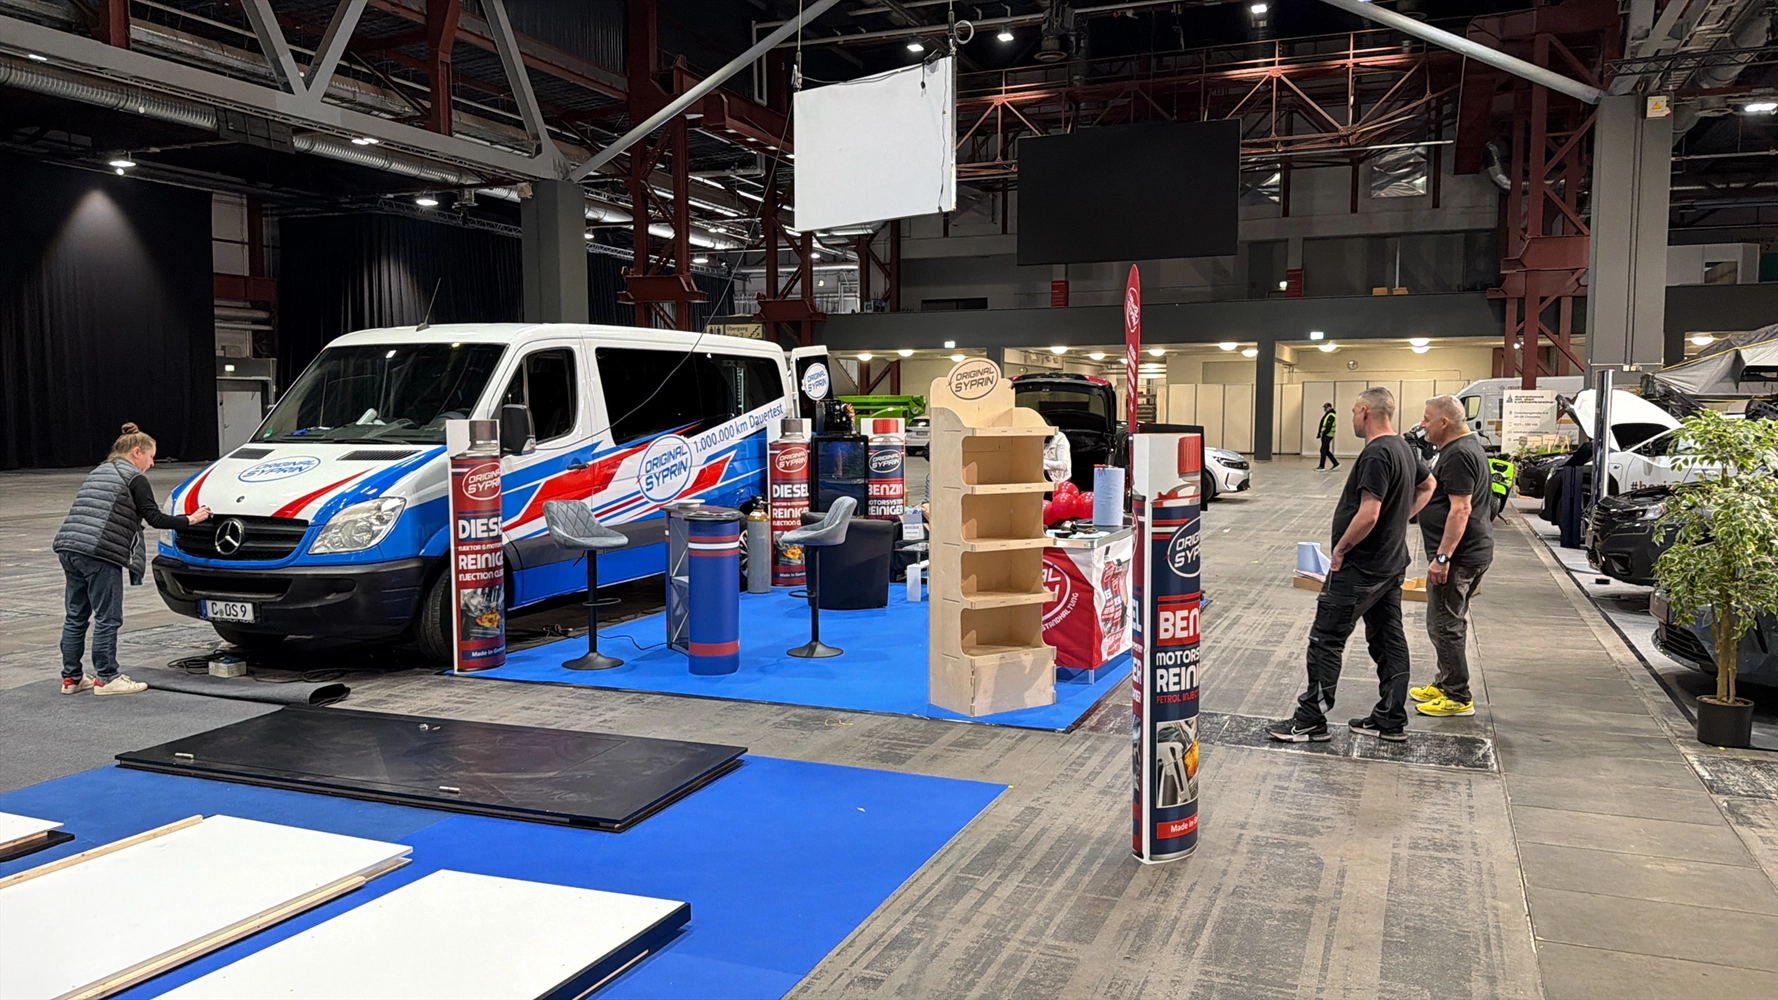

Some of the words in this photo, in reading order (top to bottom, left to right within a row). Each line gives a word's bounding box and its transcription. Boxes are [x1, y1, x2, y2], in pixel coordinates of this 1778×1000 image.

[808, 370, 826, 382] ORIGINAL
[956, 366, 994, 381] ORIGINAL
[808, 378, 826, 392] SYPRIN
[954, 375, 994, 392] SYPRIN
[694, 424, 735, 454] 1.000.000
[735, 420, 748, 436] km
[748, 402, 784, 428] Dauertest
[645, 445, 688, 474] ORIGINAL
[778, 456, 807, 468] SYPRIN
[779, 452, 807, 462] ORIGINAL
[872, 453, 900, 462] ORIGINAL
[872, 459, 901, 468] SYPRIN
[242, 466, 310, 478] SYPRIN
[646, 458, 688, 492] SYPRIN
[772, 484, 810, 498] DIESEL
[868, 484, 903, 496] BENZIN
[458, 572, 494, 581] INJECTION
[212, 602, 218, 616] C
[240, 604, 247, 618] 9
[1156, 694, 1181, 704] PETROL
[1170, 822, 1188, 833] Made
